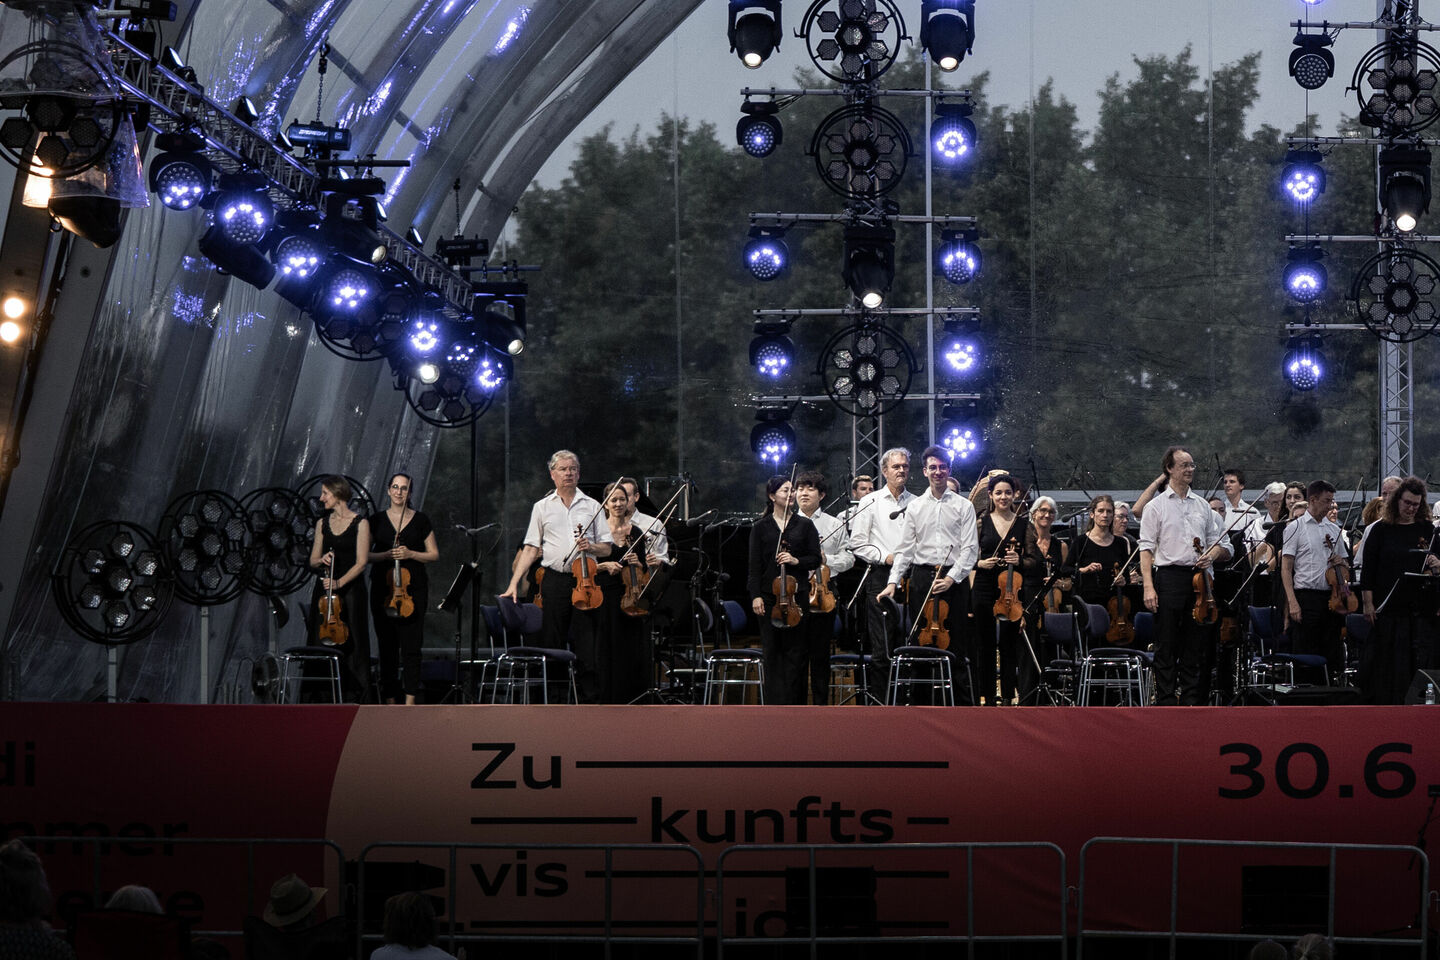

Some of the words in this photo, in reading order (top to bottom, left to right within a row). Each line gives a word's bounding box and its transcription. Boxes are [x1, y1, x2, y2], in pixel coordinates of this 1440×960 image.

[471, 742, 561, 789] Zu
[651, 797, 894, 843] kunfts
[470, 851, 568, 897] vis
